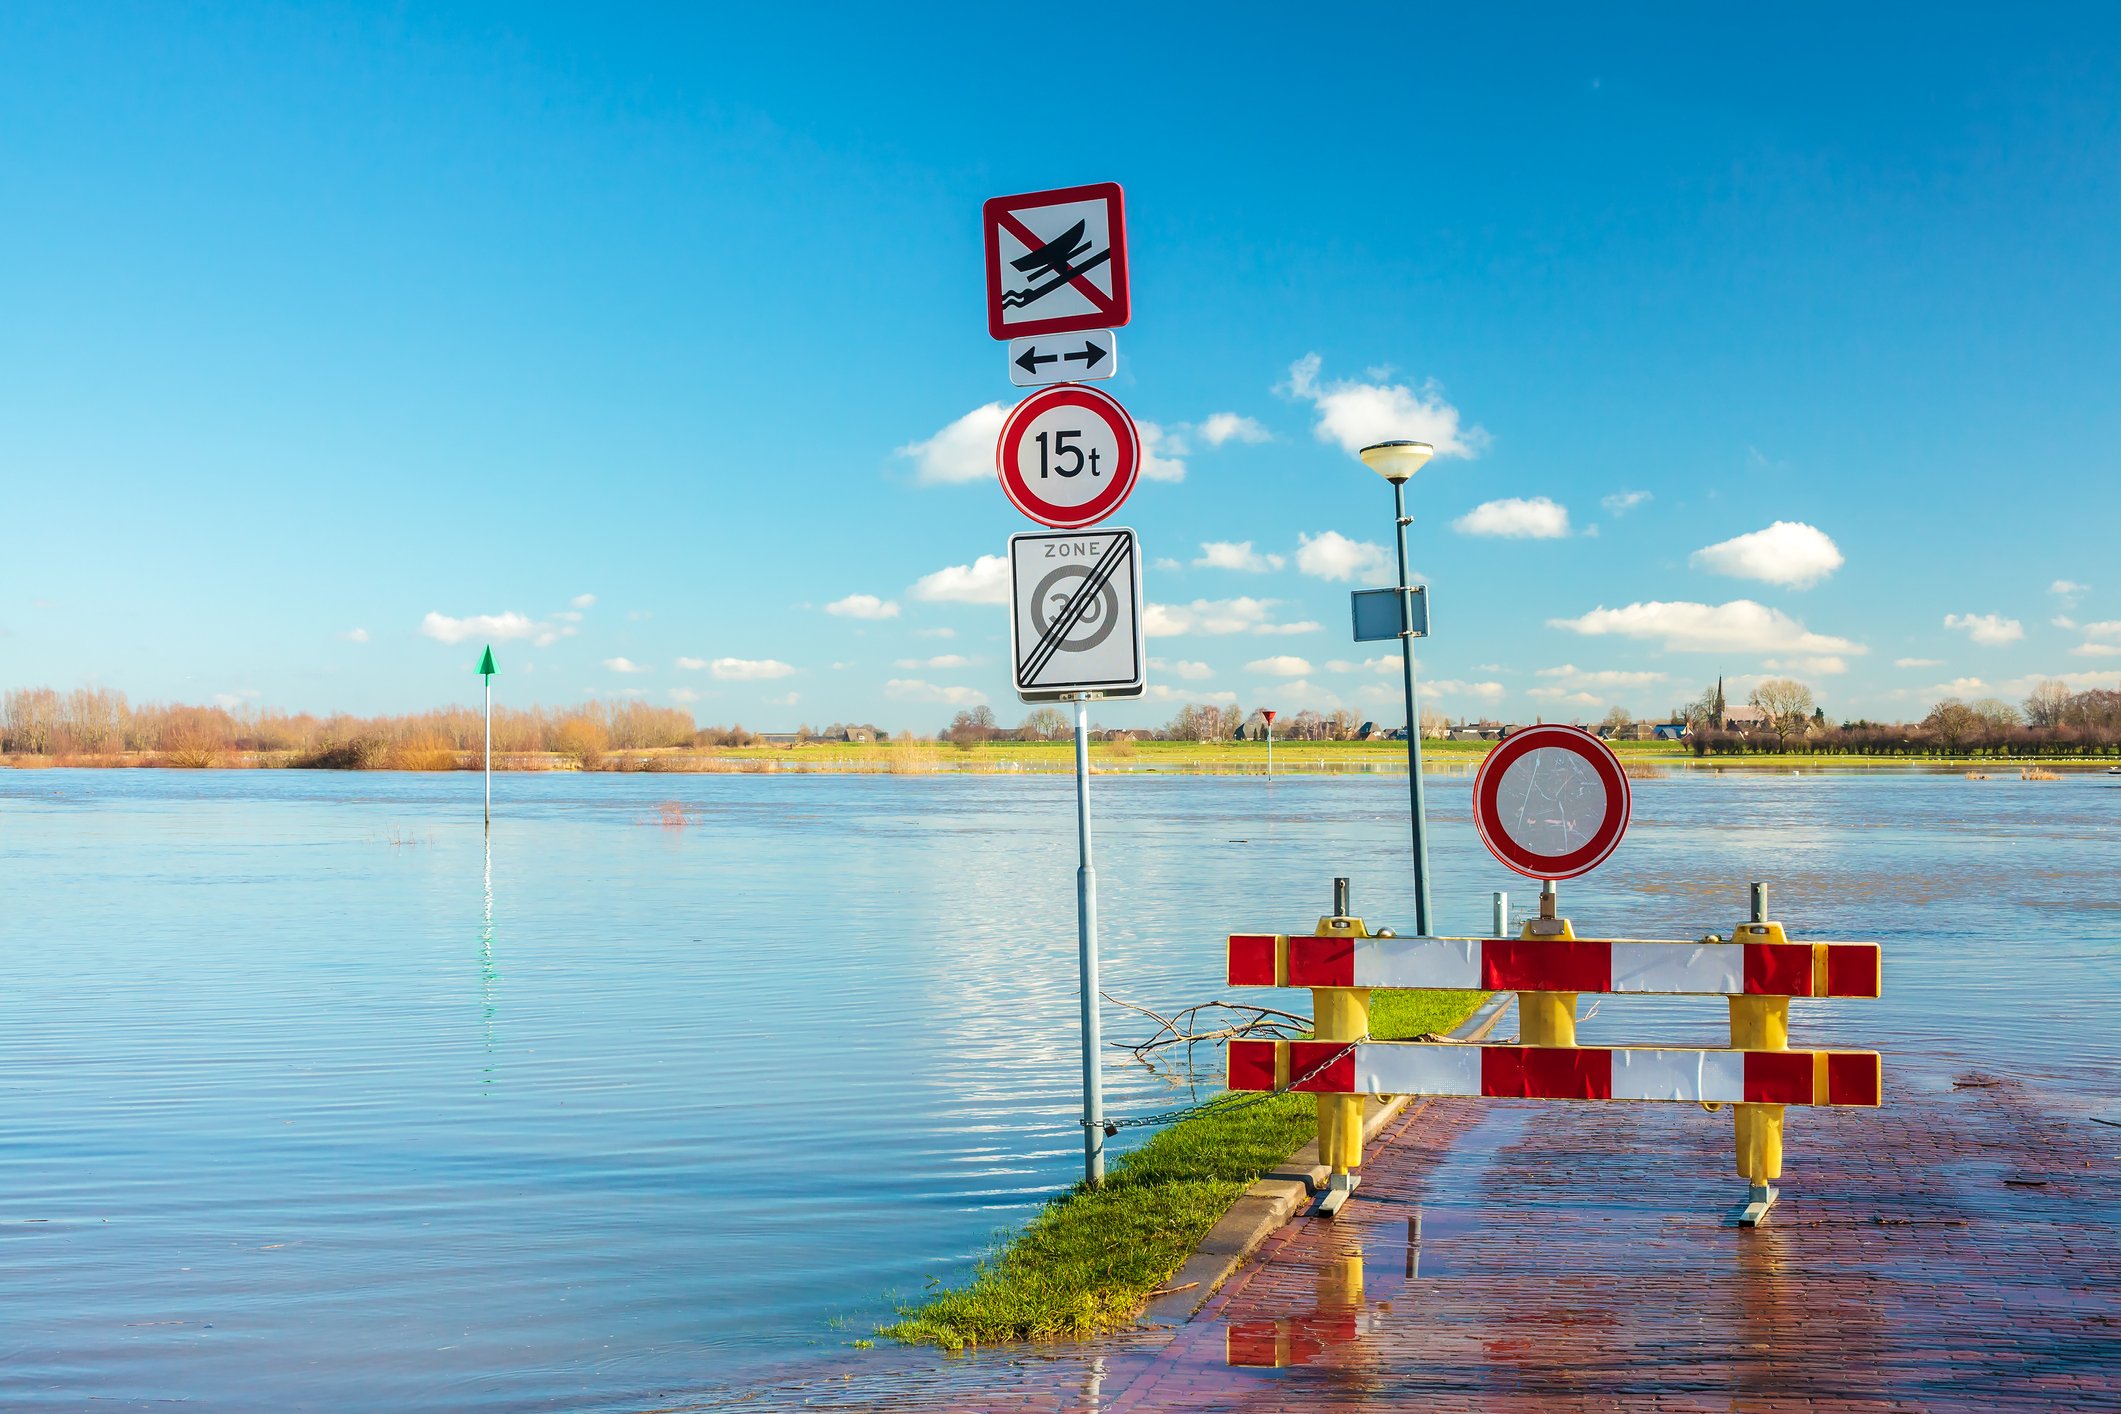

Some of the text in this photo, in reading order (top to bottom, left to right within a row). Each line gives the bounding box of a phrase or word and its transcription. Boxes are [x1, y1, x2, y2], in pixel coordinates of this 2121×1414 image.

[1035, 430, 1101, 479] 15t
[1044, 542, 1101, 558] ZONE
[1049, 591, 1101, 625] 30
